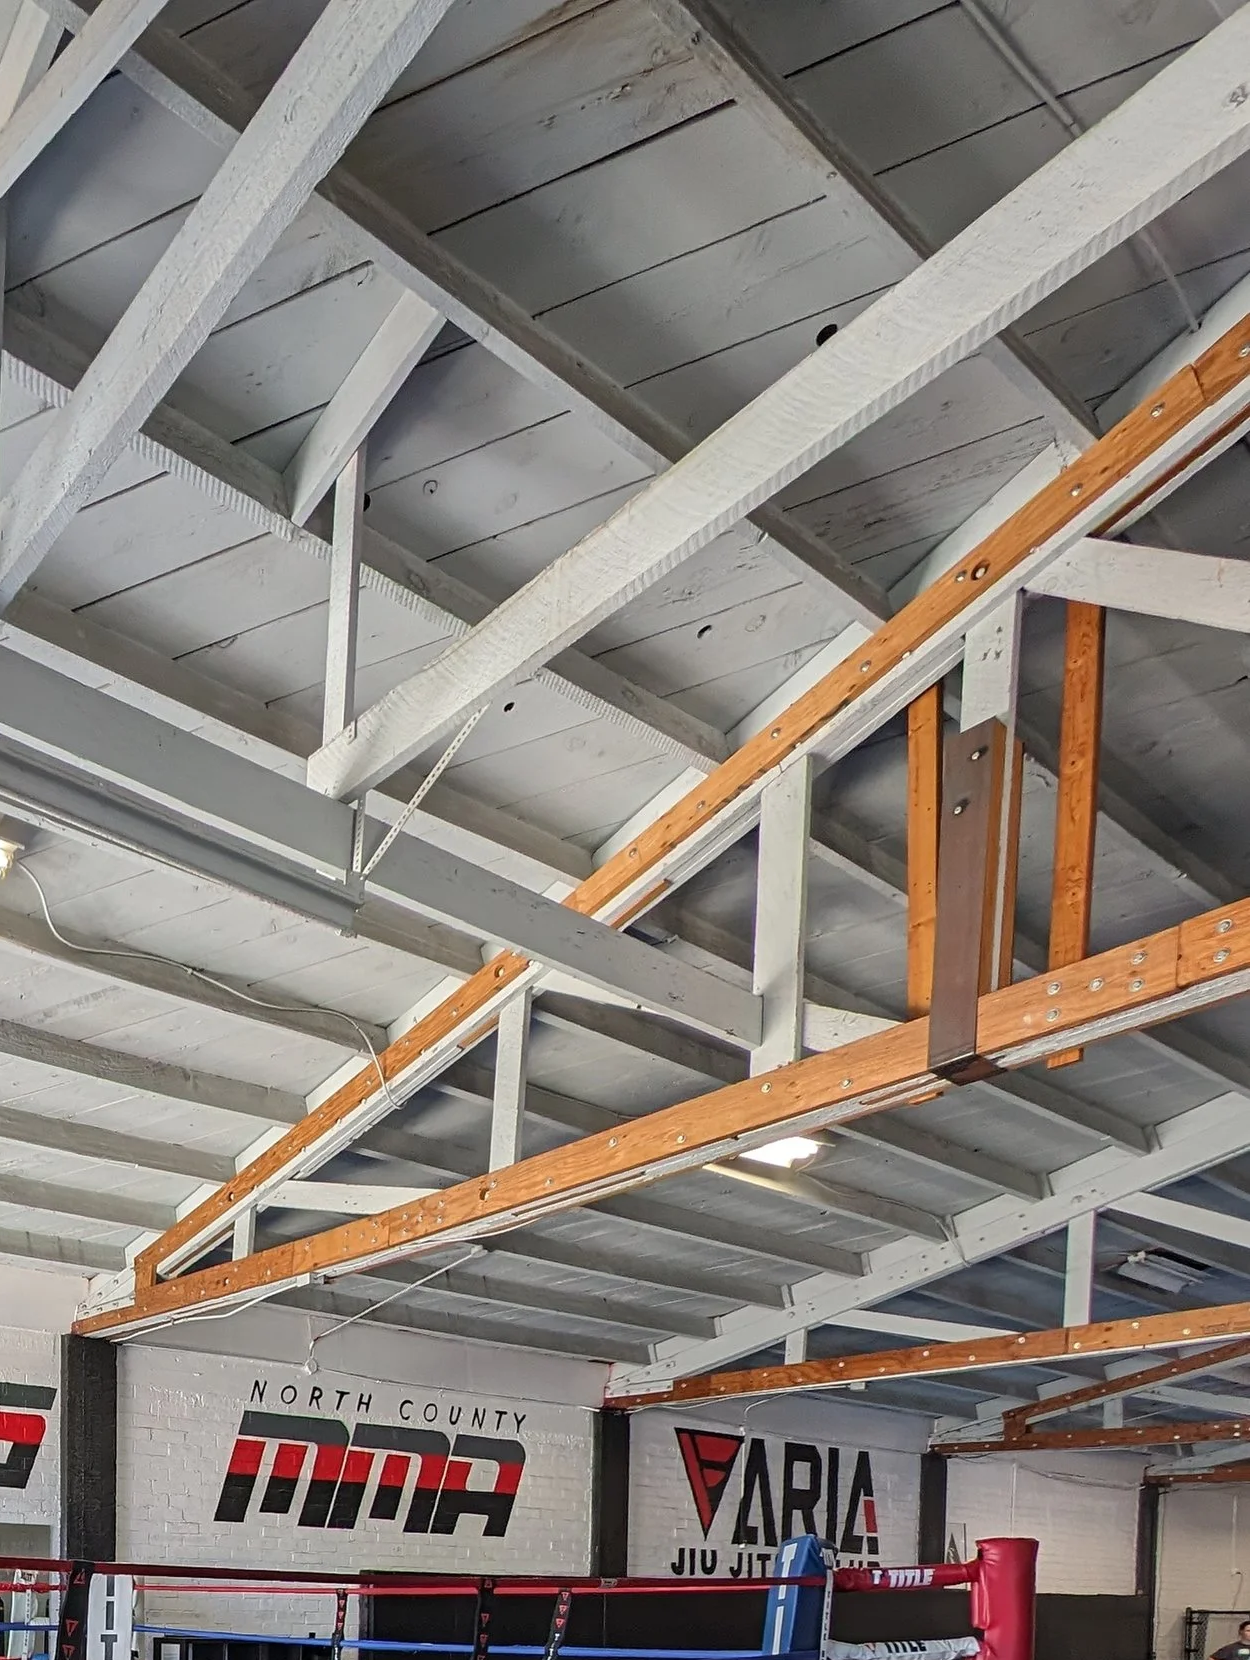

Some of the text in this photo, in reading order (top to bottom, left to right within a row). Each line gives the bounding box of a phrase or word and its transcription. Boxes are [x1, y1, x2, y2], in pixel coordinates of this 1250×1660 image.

[250, 1379, 527, 1433] NORTH COUNTY
[213, 1410, 527, 1538] MMA
[671, 1548, 717, 1575] JIU
[888, 1568, 935, 1588] TITLE
[885, 1641, 928, 1654] TITLE
